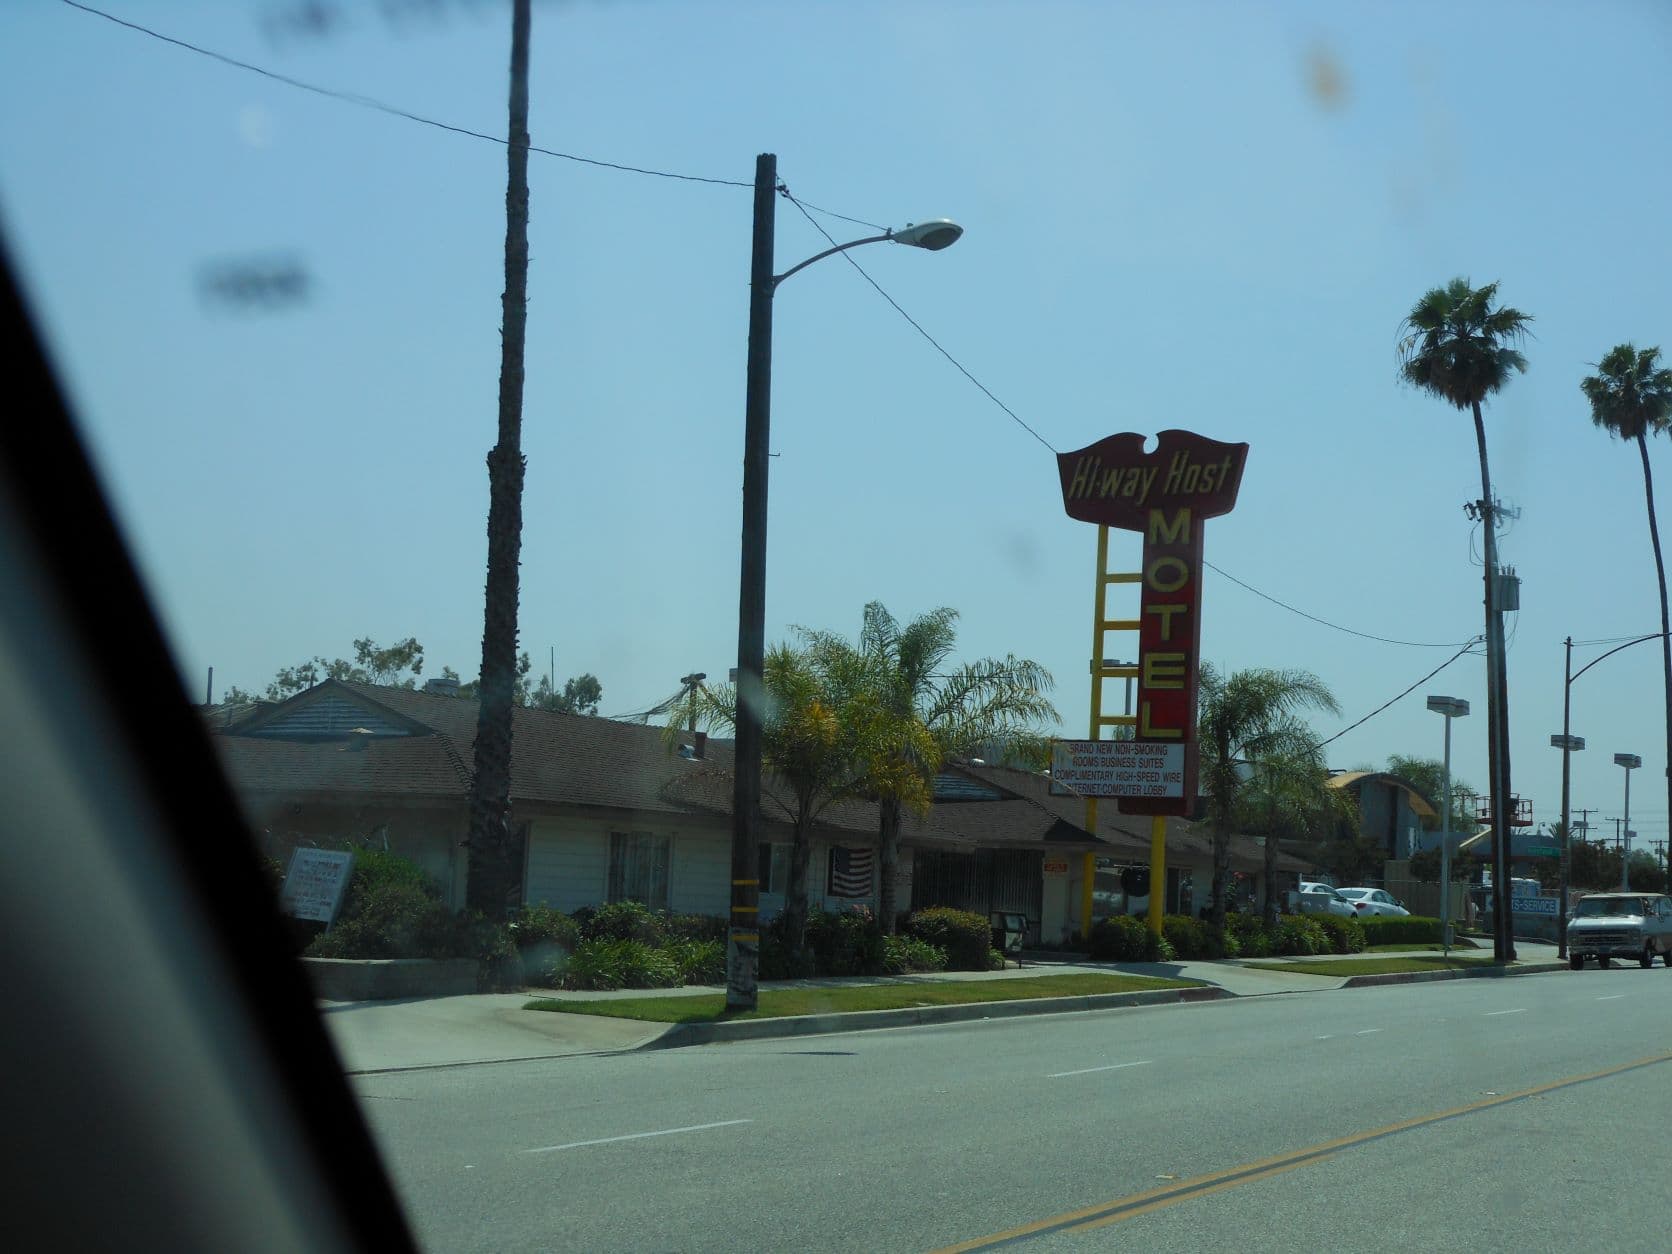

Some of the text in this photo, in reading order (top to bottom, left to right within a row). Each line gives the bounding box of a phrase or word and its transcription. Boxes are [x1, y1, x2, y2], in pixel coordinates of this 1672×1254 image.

[1164, 450, 1232, 495] Host
[1140, 508, 1191, 738] MOTEL
[1070, 743, 1168, 755] BRAND NEW NON-SMOKING
[1072, 757, 1165, 769] ROOMS BUSINESS SUITES
[1054, 769, 1181, 783] COMPLIMENTARY HIGH-SPEED WIRE
[1102, 784, 1141, 795] COMPUTER
[1144, 785, 1168, 796] LOBBY
